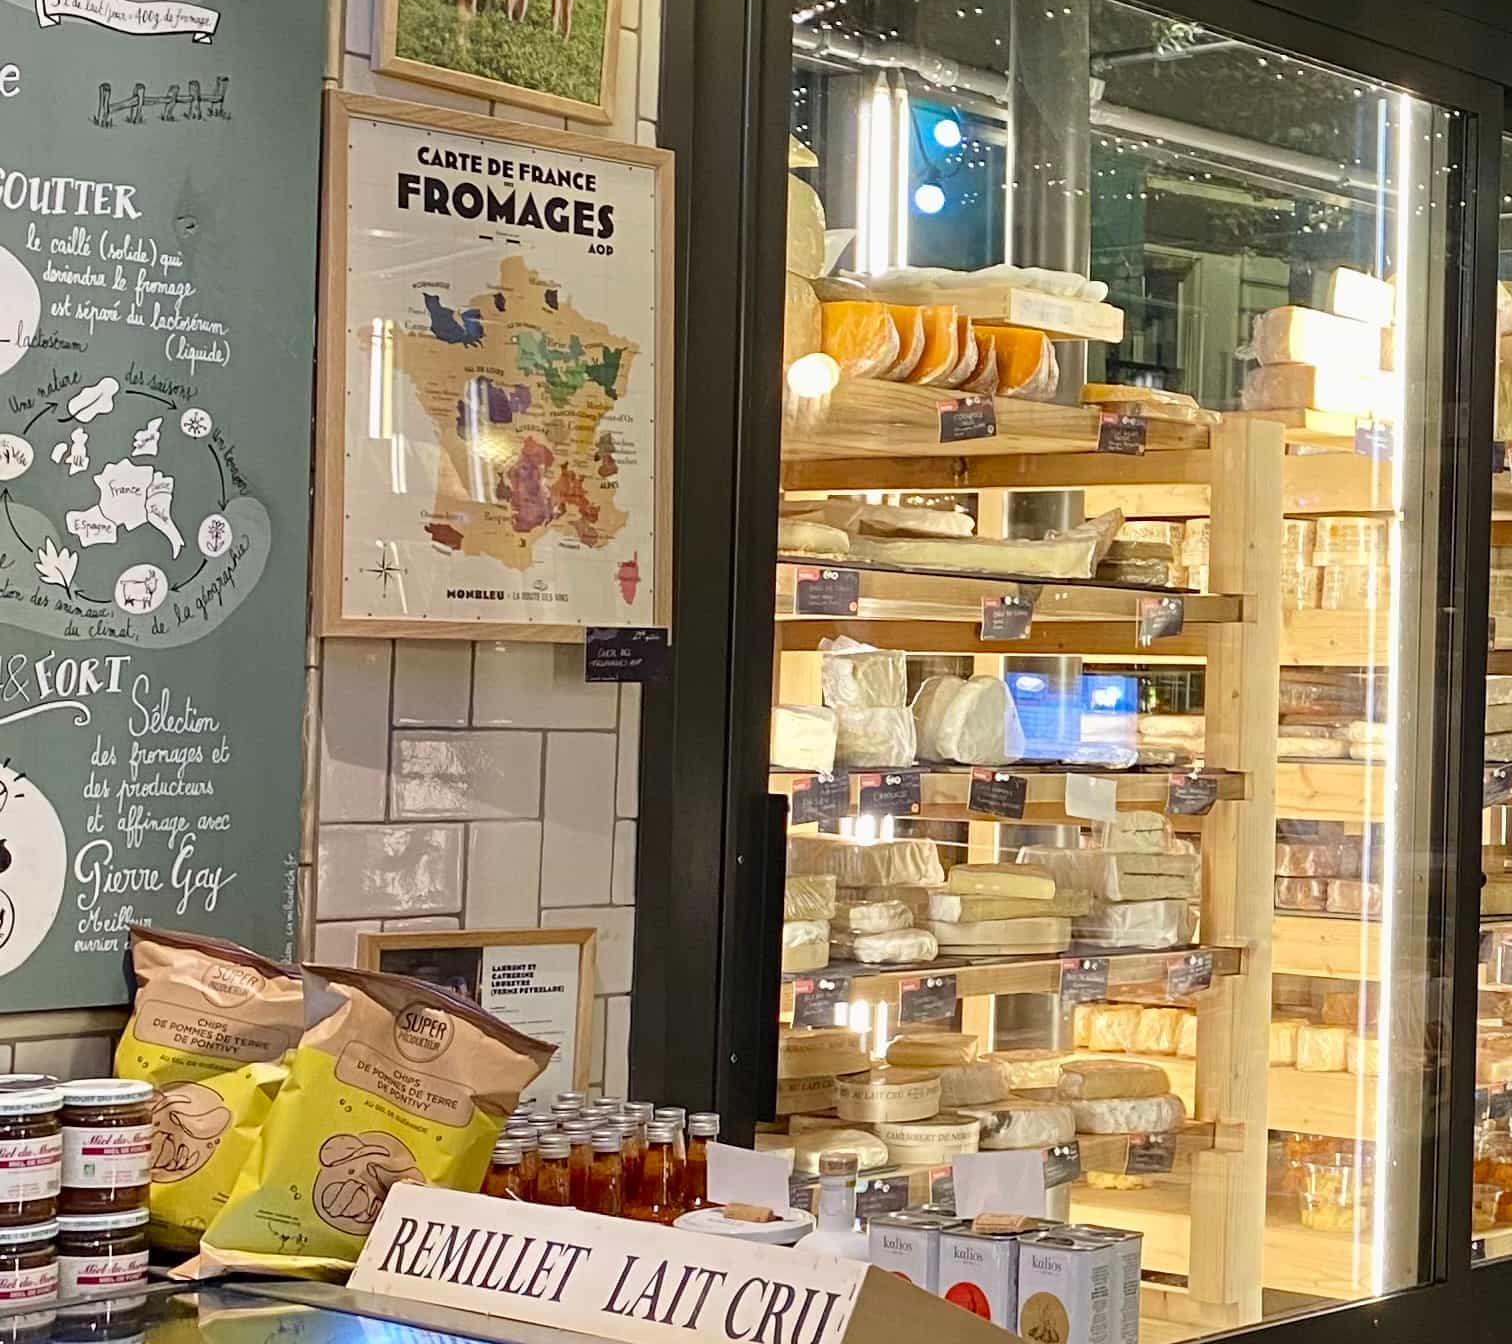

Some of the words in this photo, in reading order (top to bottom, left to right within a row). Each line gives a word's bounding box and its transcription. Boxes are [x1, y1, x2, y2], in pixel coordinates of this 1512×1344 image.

[417, 146, 482, 173] CARTE
[487, 158, 514, 179] DE
[519, 162, 596, 192] FRANCE
[397, 172, 615, 239] FROMAGES
[26, 222, 41, 251] le
[51, 226, 92, 256] caillé
[160, 251, 183, 276] qui
[588, 243, 614, 256] AOP
[112, 265, 127, 291] le
[135, 268, 196, 309] fromage
[51, 294, 71, 317] est
[75, 300, 120, 335] séparé
[127, 303, 145, 326] du
[150, 302, 230, 336] lactosérum
[15, 319, 88, 353] lactosérum
[108, 479, 143, 497] France
[30, 587, 48, 607] des
[446, 589, 505, 601] MONBLEU
[64, 620, 80, 637] du
[151, 616, 169, 635] de
[174, 603, 194, 625] la
[34, 649, 131, 699] FORT
[128, 673, 220, 737] Sélection
[91, 734, 117, 766] des
[129, 741, 203, 782] fromages
[212, 735, 231, 764] et
[83, 770, 111, 798] des
[116, 772, 215, 814] producteurs
[87, 803, 104, 832] et
[117, 805, 190, 849] affinage
[197, 812, 231, 831] avec
[74, 839, 164, 911] Pierre
[171, 832, 238, 915] Gay
[153, 1018, 168, 1028] DE
[170, 1022, 213, 1040] POMMES
[215, 1032, 233, 1044] DE
[234, 1036, 272, 1050] TERRE
[173, 1033, 188, 1044] DE
[197, 1018, 229, 1033] CHIPS
[401, 1012, 447, 1040] SUPER
[357, 1060, 370, 1073] DE
[372, 1067, 406, 1092] POMMES
[408, 1087, 424, 1098] DE
[426, 1092, 459, 1110] TERRE
[377, 1081, 389, 1093] DE
[390, 1088, 431, 1111] PONTIVY
[393, 1070, 421, 1088] CHIPS
[83, 1134, 112, 1146] Miel
[883, 1235, 913, 1252] kalios
[953, 1245, 984, 1262] kalios
[377, 1217, 592, 1303] REMILLET
[601, 1255, 728, 1330] LAIT
[1031, 1255, 1062, 1273] kalios
